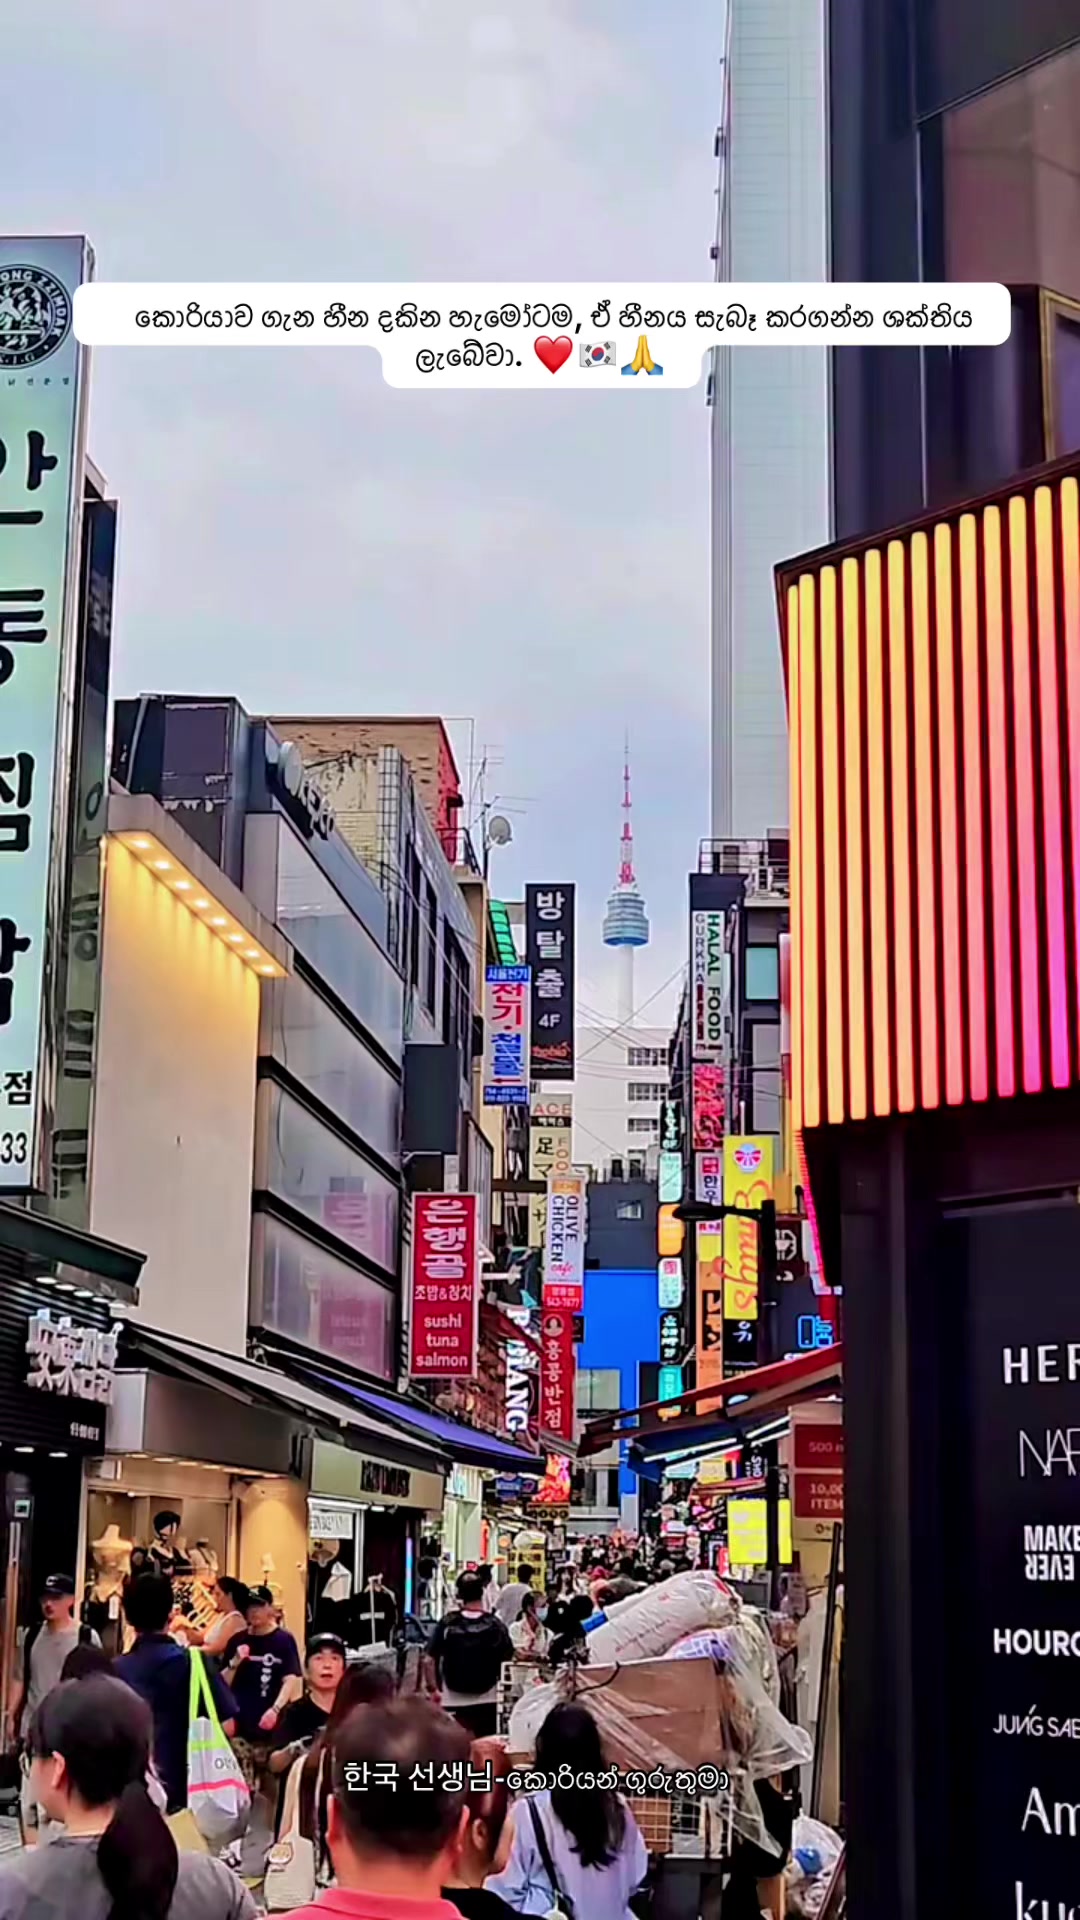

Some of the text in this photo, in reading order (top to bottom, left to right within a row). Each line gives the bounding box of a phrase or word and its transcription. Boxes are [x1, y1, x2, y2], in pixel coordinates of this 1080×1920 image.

[37, 274, 67, 337] ZZIMDAK
[535, 891, 565, 999] 방탈출
[707, 914, 721, 1041] HALAL FOOD
[538, 1014, 561, 1028] 4F
[550, 1195, 565, 1263] CHICKEN
[565, 1195, 579, 1243] OLIVE
[424, 1313, 462, 1328] sushi
[426, 1333, 459, 1348] tuna
[416, 1352, 468, 1367] salmon
[543, 1338, 564, 1428] 홍콩반점
